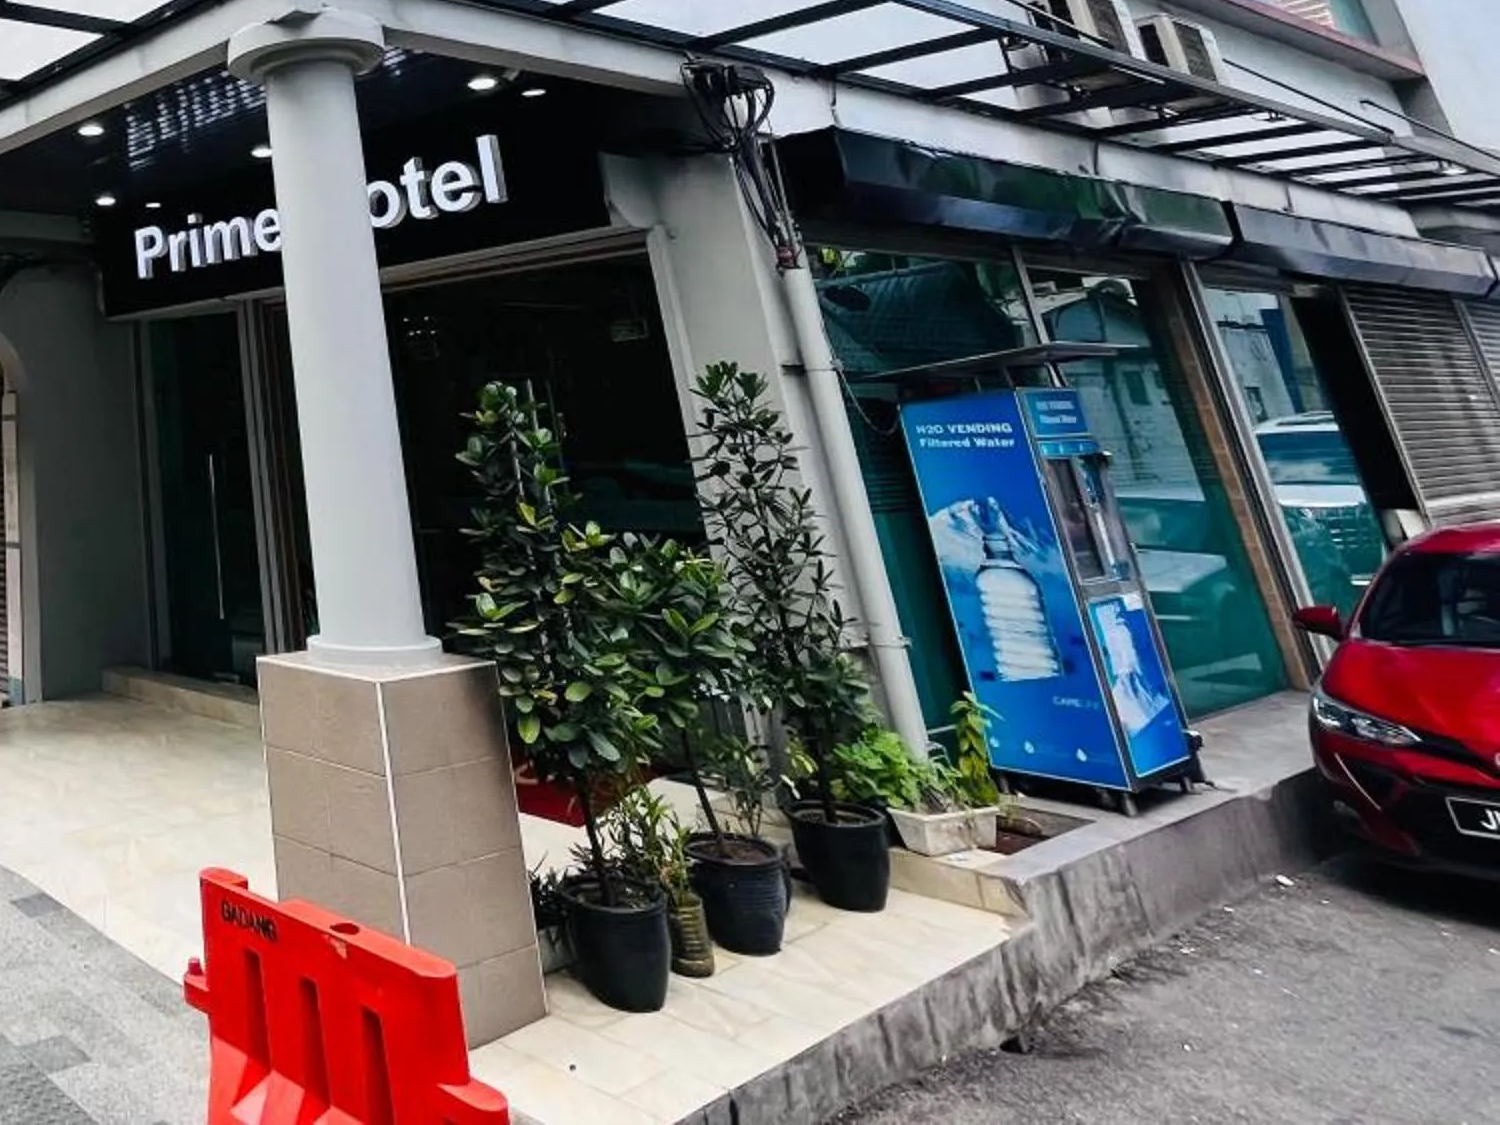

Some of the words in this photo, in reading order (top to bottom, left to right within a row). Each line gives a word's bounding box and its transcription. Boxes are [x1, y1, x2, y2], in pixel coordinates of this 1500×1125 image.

[135, 207, 282, 280] Prime
[366, 134, 507, 229] otel
[947, 422, 1013, 435] VENDING
[919, 437, 971, 448] Filtered
[973, 437, 1015, 448] Water
[1480, 807, 1500, 830] J
